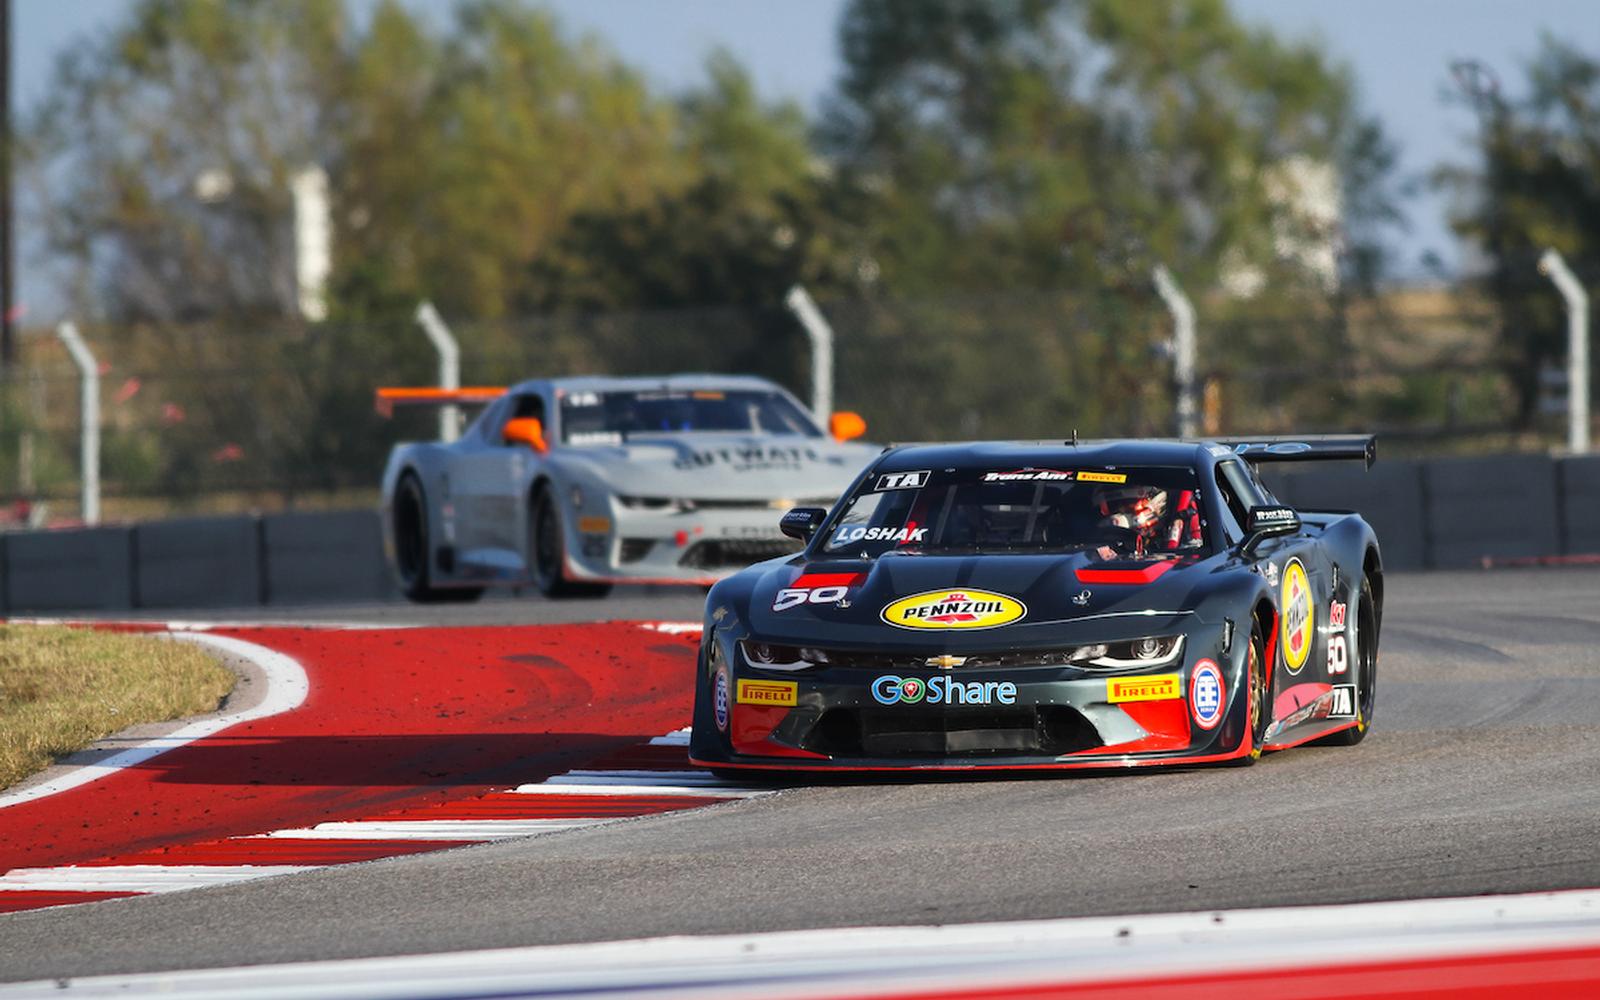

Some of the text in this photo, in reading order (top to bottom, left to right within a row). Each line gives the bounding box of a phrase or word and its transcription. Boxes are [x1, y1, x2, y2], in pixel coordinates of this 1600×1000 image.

[886, 474, 922, 488] TA
[983, 471, 1068, 482] Trans Am
[836, 527, 929, 542] LOSHAK
[773, 586, 850, 612] 50
[903, 600, 1005, 620] PENNZOIL
[1327, 635, 1347, 675] 50
[742, 684, 793, 701] PIRELLI
[1113, 679, 1173, 697] PIRELLI
[1331, 687, 1352, 714] TA
